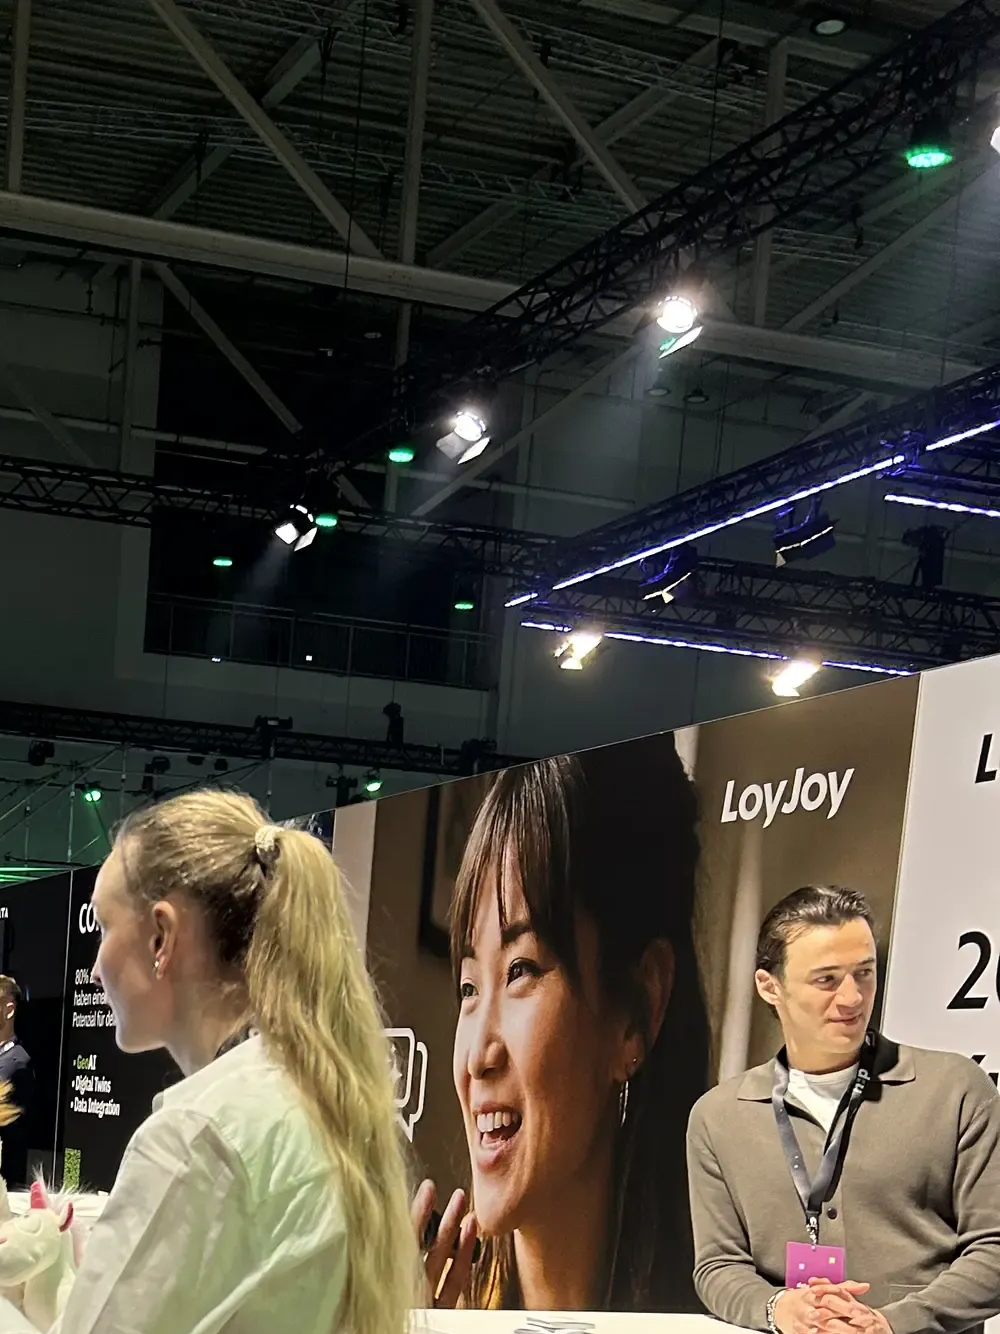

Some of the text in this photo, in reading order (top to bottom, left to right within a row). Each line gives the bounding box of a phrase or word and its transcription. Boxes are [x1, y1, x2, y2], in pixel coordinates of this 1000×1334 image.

[975, 733, 1000, 783] L
[721, 767, 855, 828] LoyJoy
[79, 903, 99, 934] CO
[947, 931, 1000, 1010] 2
[75, 1075, 111, 1095] Digital Twins
[74, 1097, 120, 1118] Data Integration
